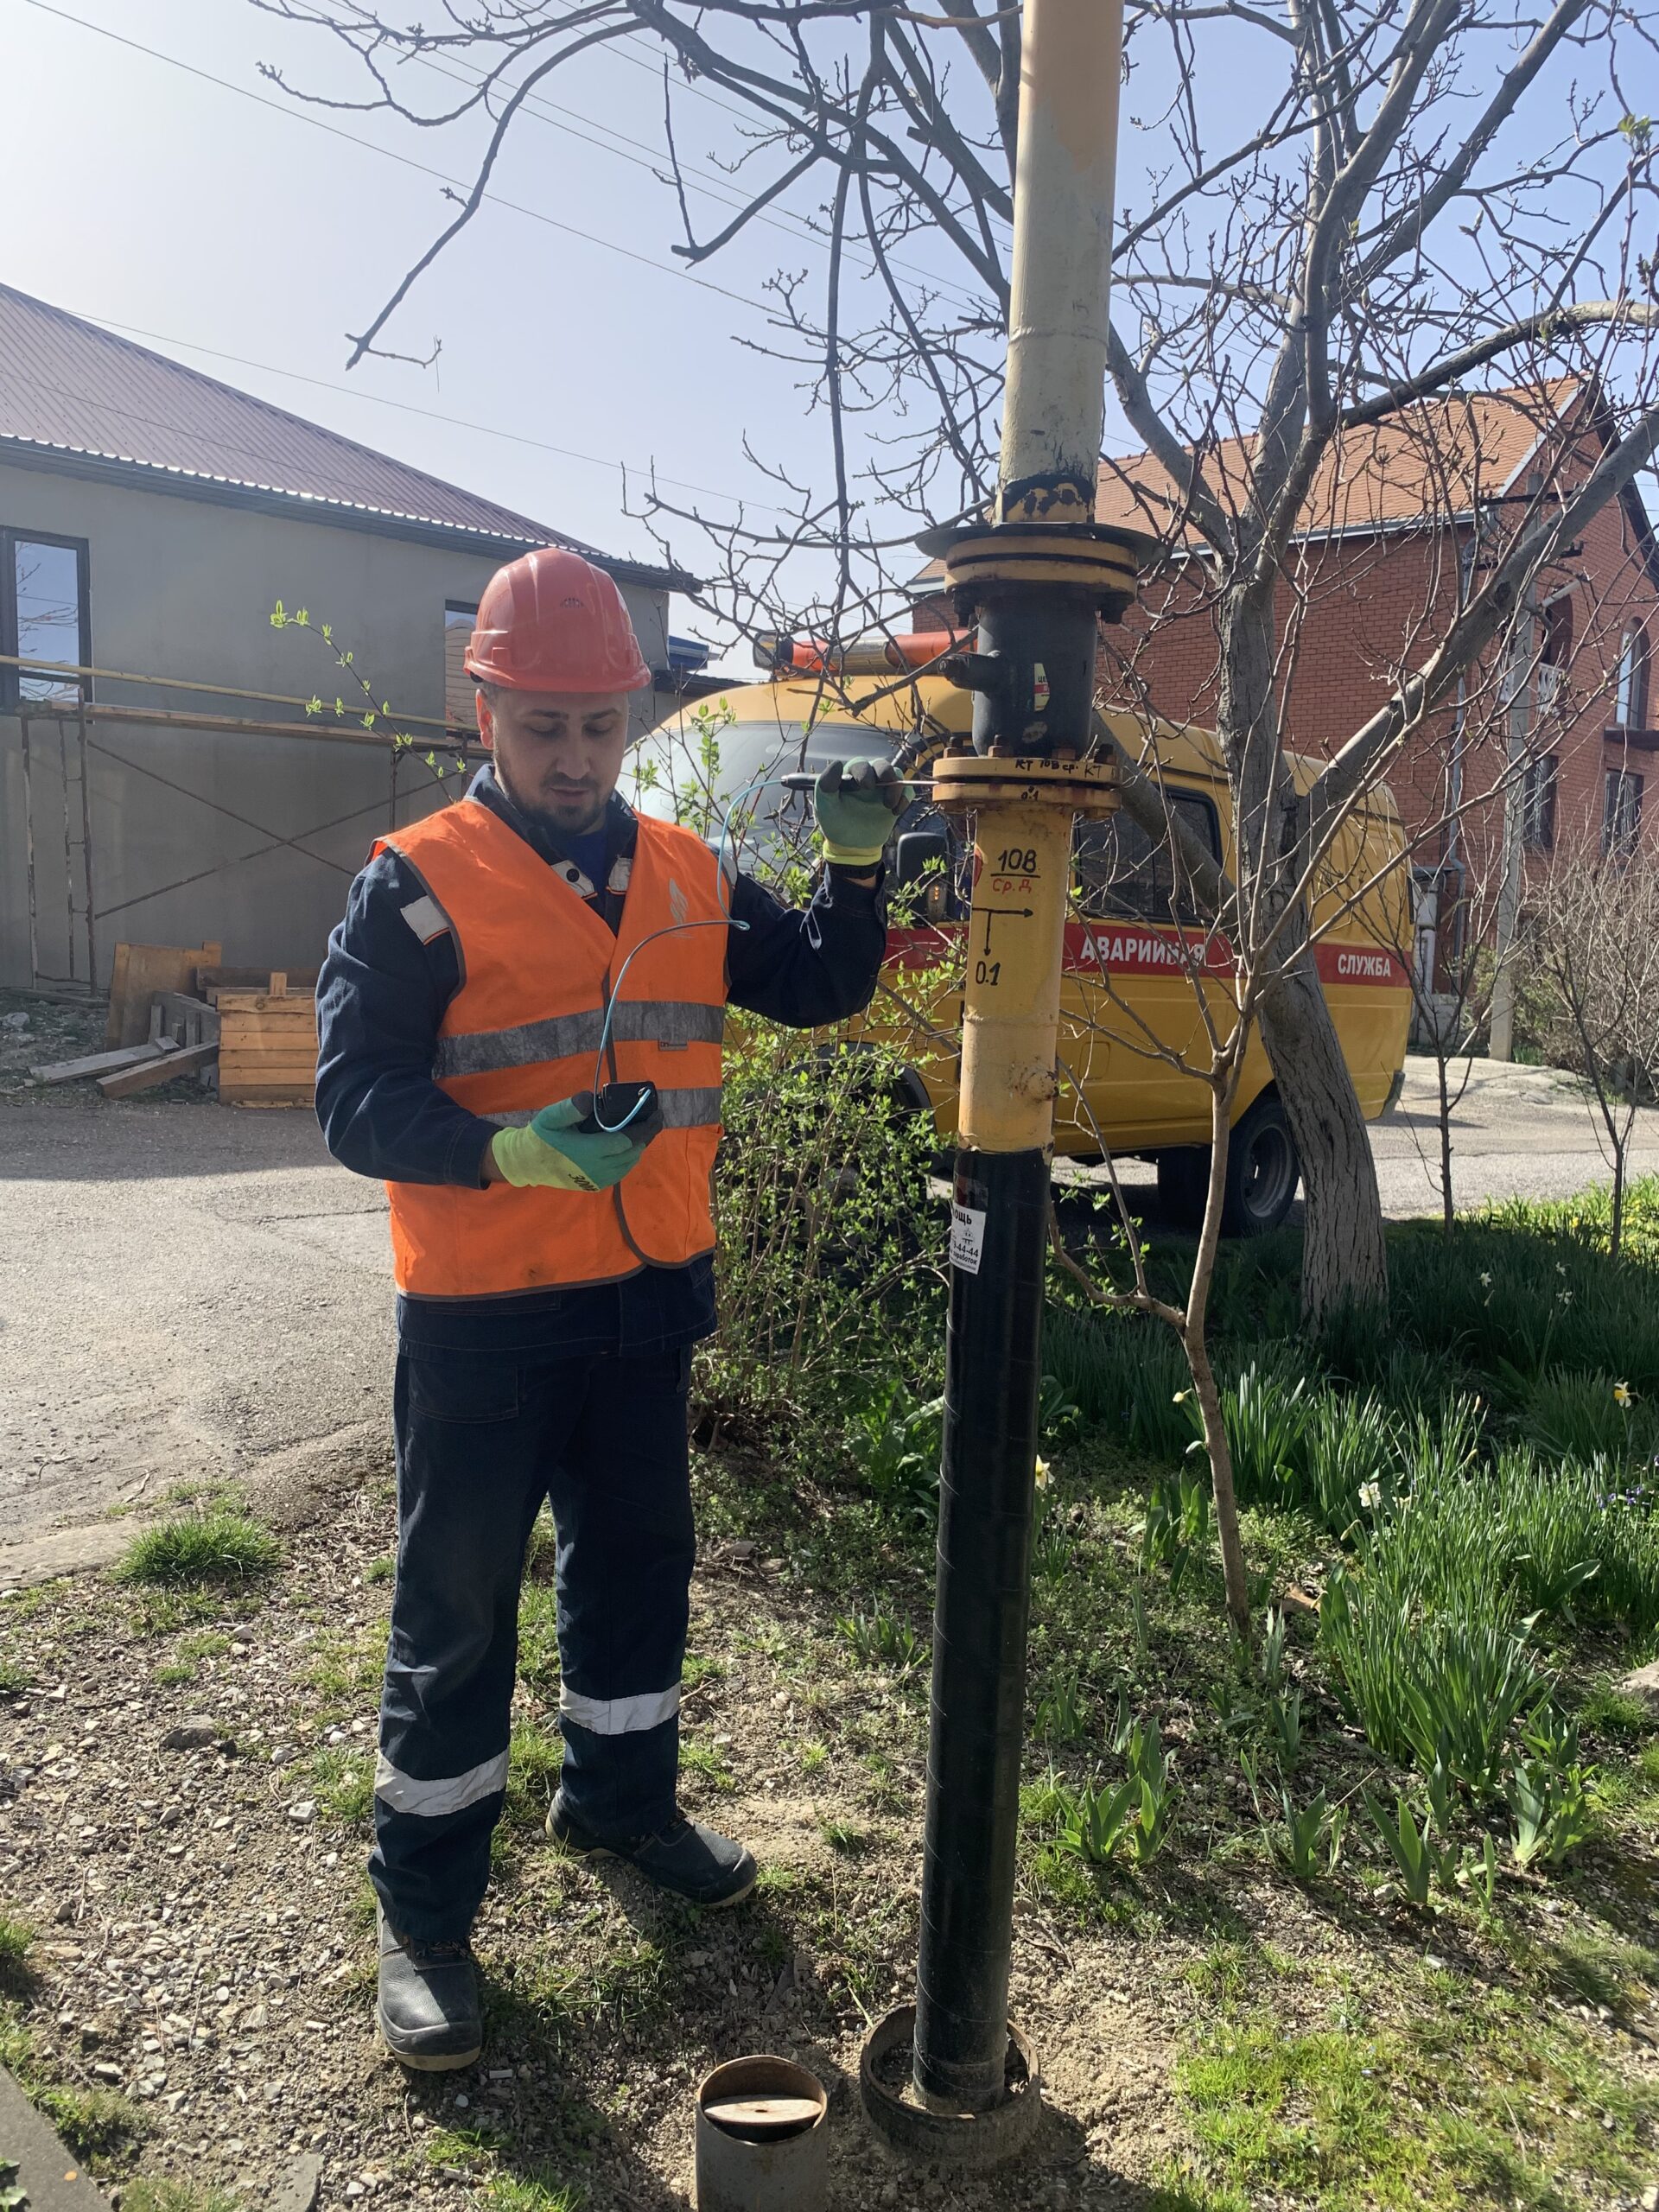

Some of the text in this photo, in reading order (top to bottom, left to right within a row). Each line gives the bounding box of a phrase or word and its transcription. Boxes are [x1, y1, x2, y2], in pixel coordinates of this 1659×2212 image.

[998, 849, 1037, 873] 108
[976, 961, 1001, 986] 0.1
[1338, 953, 1391, 977] СЛУЖБА
